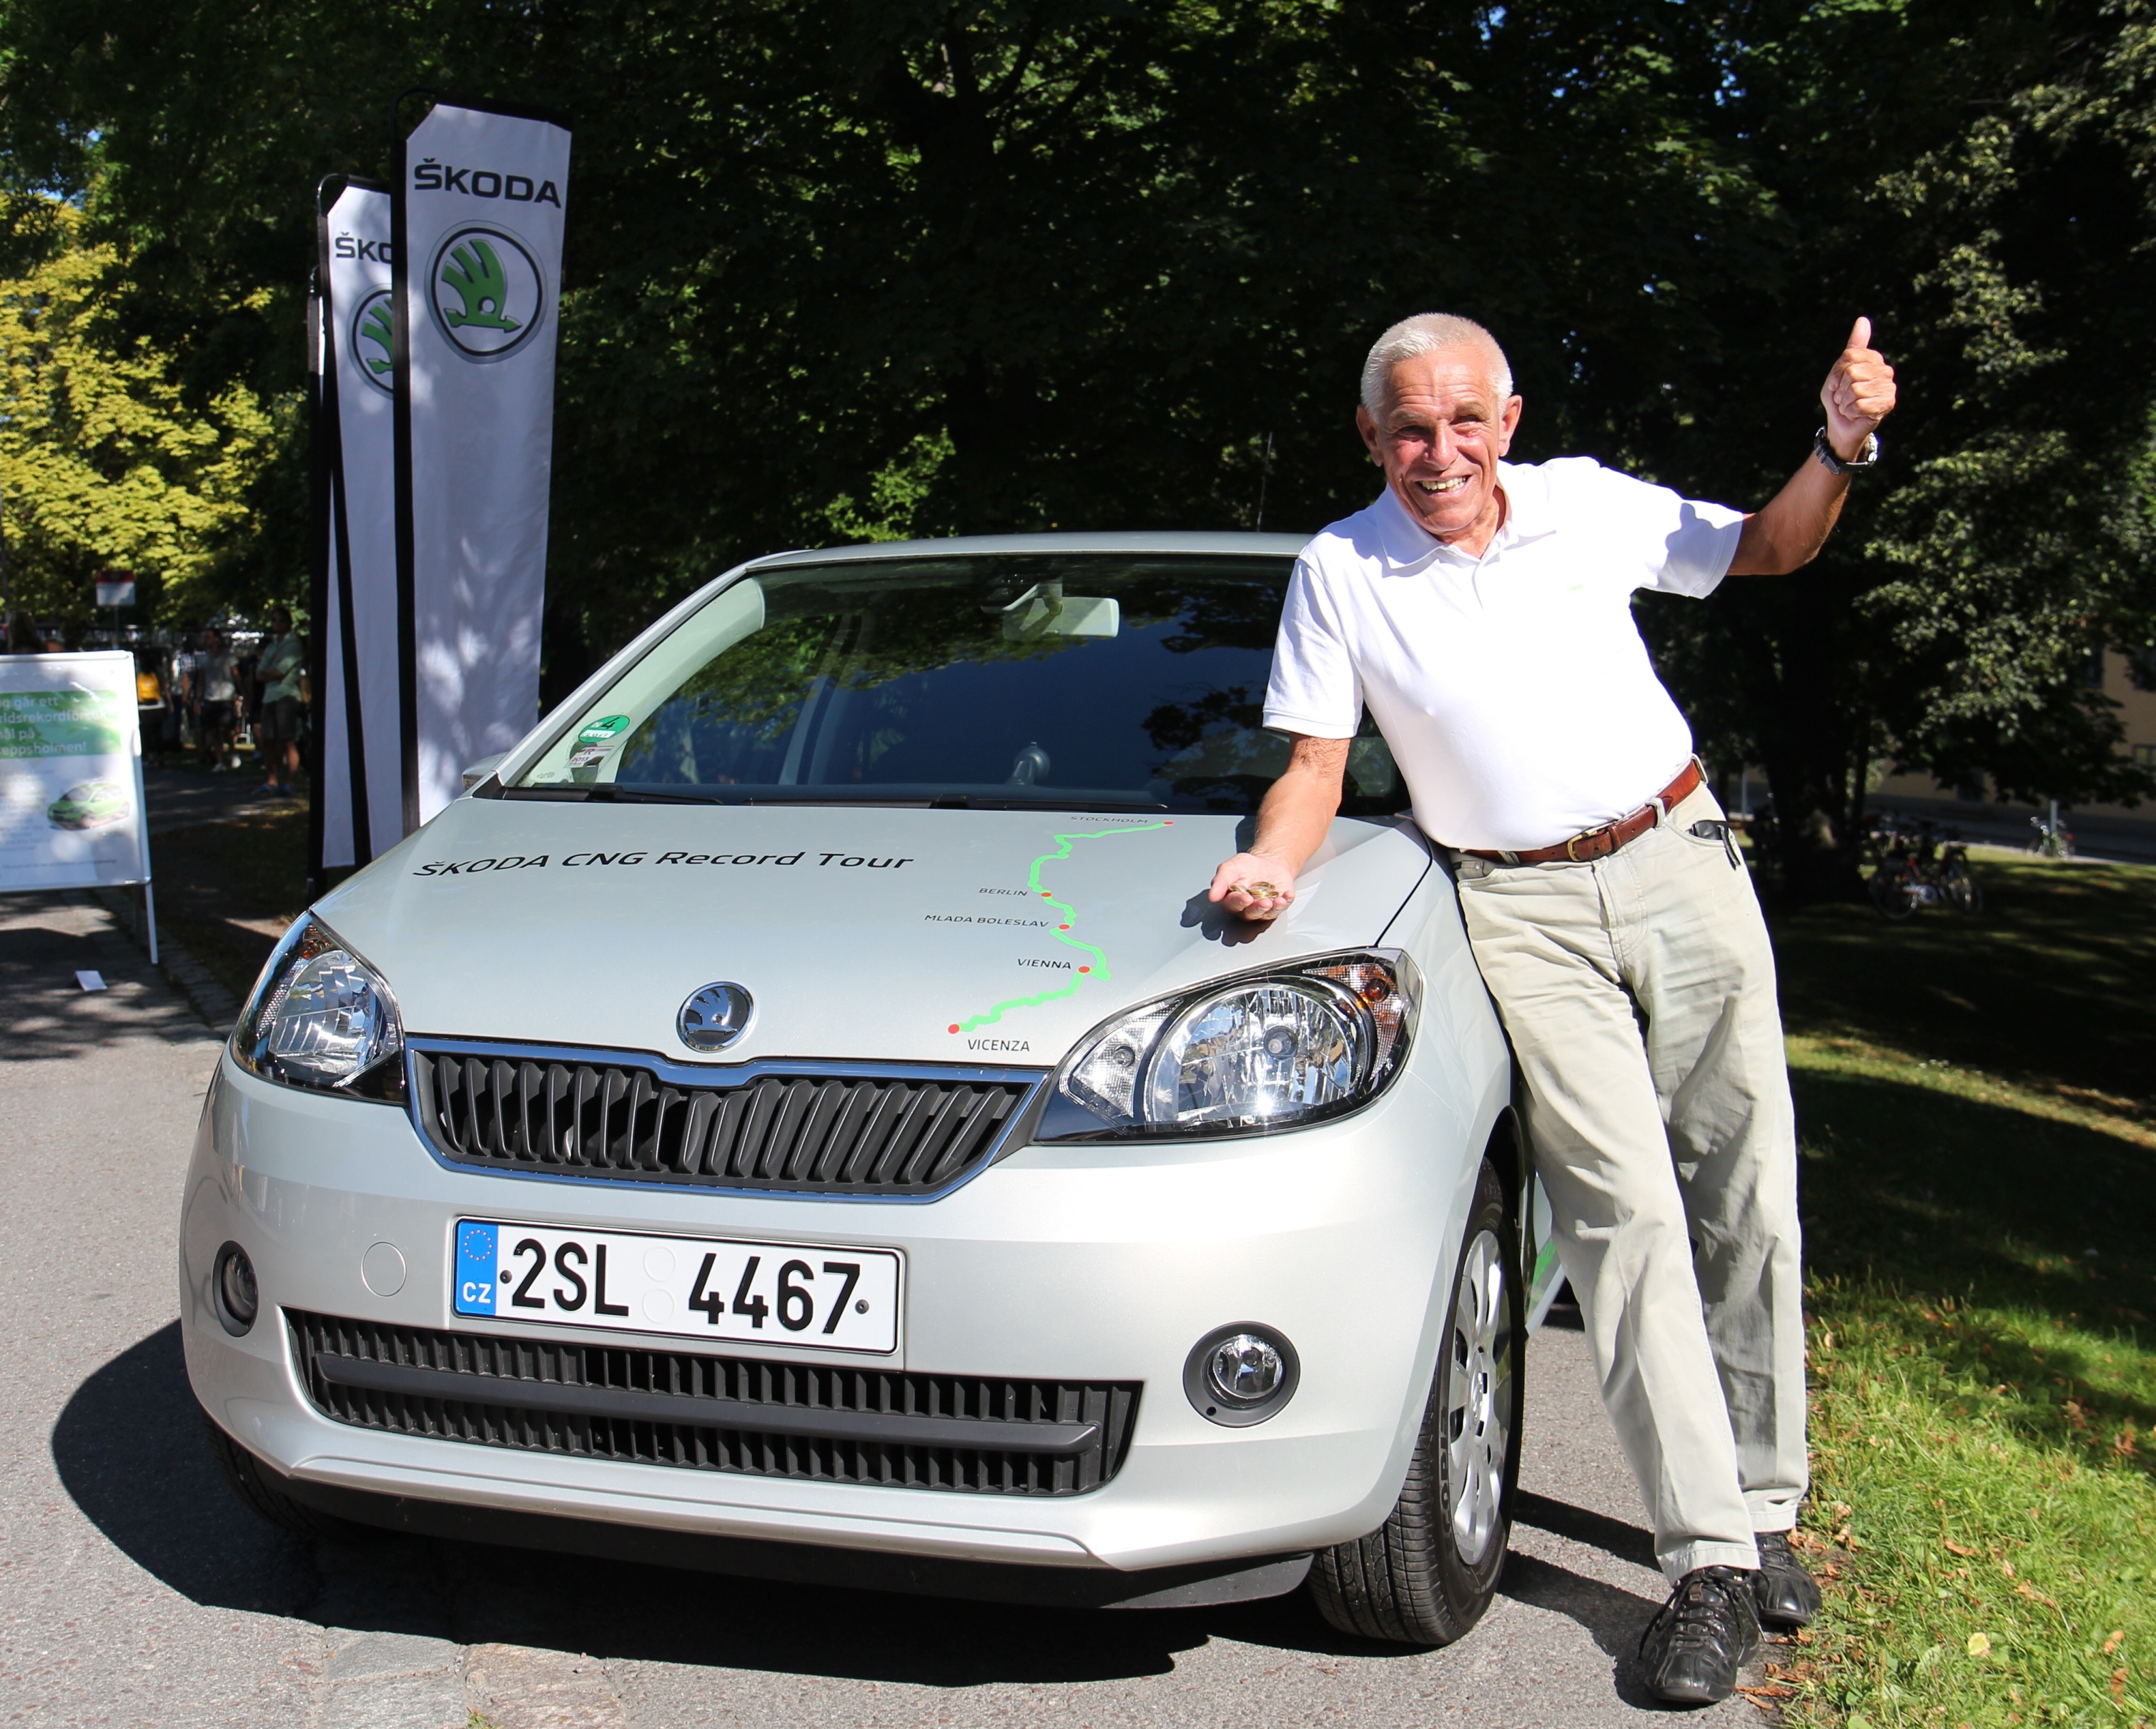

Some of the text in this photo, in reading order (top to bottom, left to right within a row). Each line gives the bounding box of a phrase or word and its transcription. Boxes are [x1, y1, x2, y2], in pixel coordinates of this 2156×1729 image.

[415, 157, 561, 209] ŠKODA
[14, 696, 34, 710] går
[39, 696, 58, 706] ett
[19, 727, 35, 741] på
[413, 852, 914, 877] ŠKODA CNG Record Tour
[979, 887, 1028, 897] BERLIN
[976, 917, 1049, 927] BOLESLAV
[1017, 958, 1072, 970] VIENNA
[967, 1039, 1030, 1052] VICENZA
[462, 1238, 861, 1335] CZ 2SL 4467
